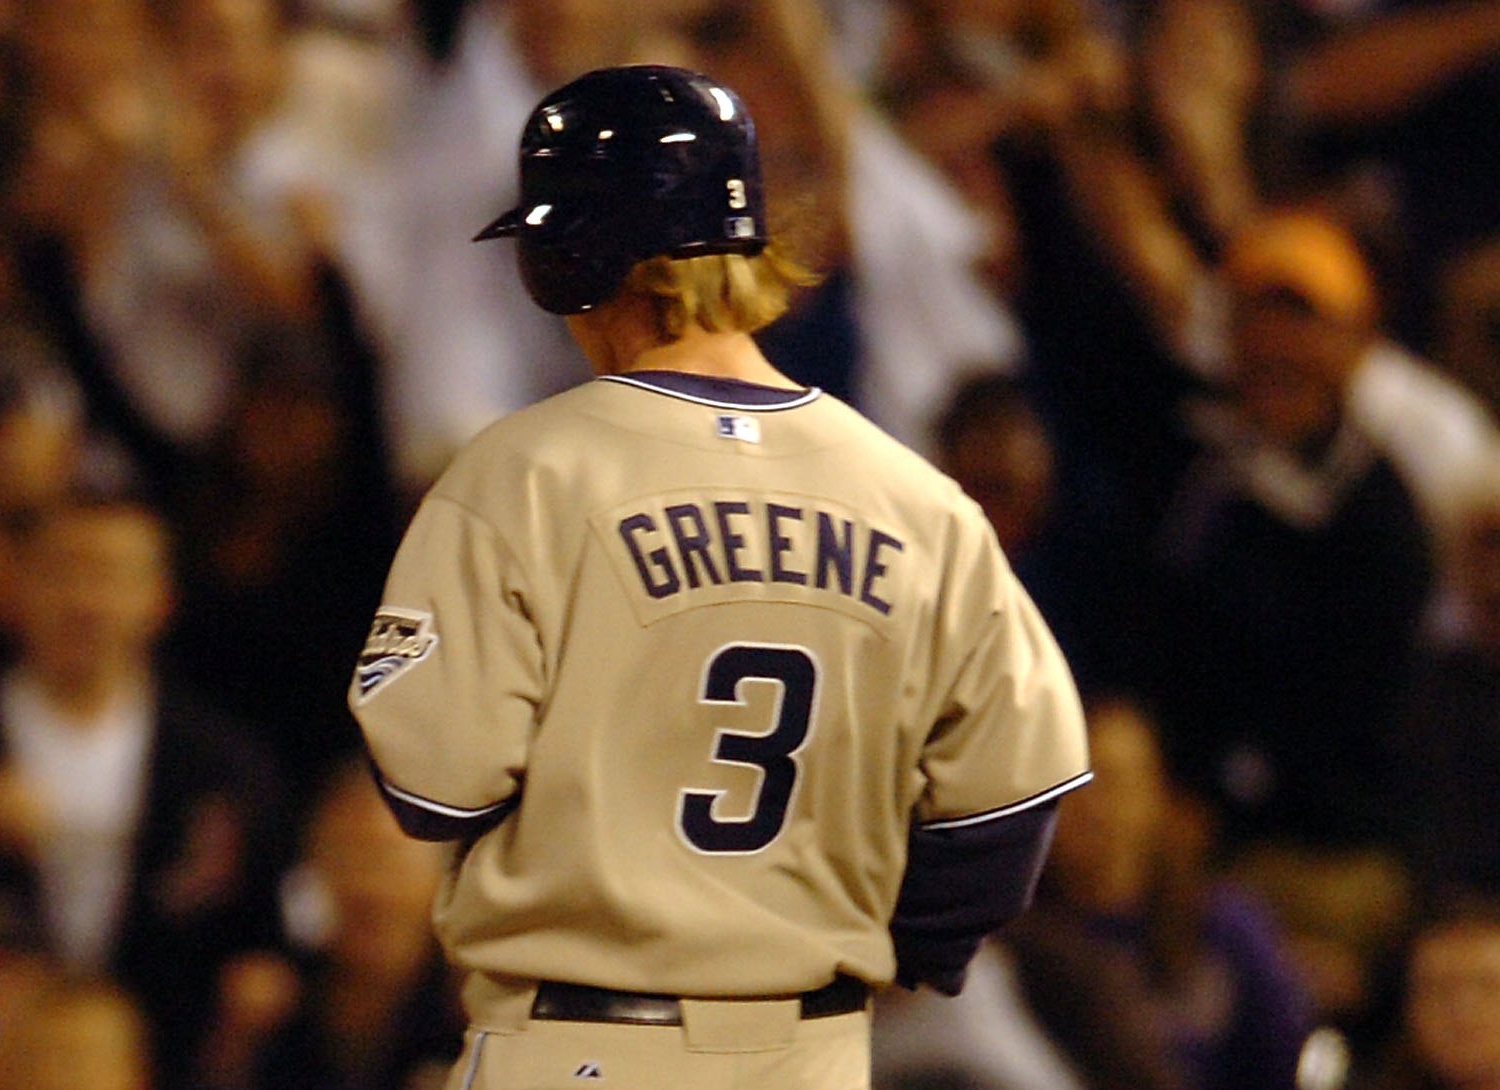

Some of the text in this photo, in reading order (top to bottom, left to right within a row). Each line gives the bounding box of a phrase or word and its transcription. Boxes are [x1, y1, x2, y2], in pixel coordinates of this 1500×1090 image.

[727, 179, 746, 209] 3
[618, 501, 904, 616] GREENE
[675, 640, 822, 855] 3
